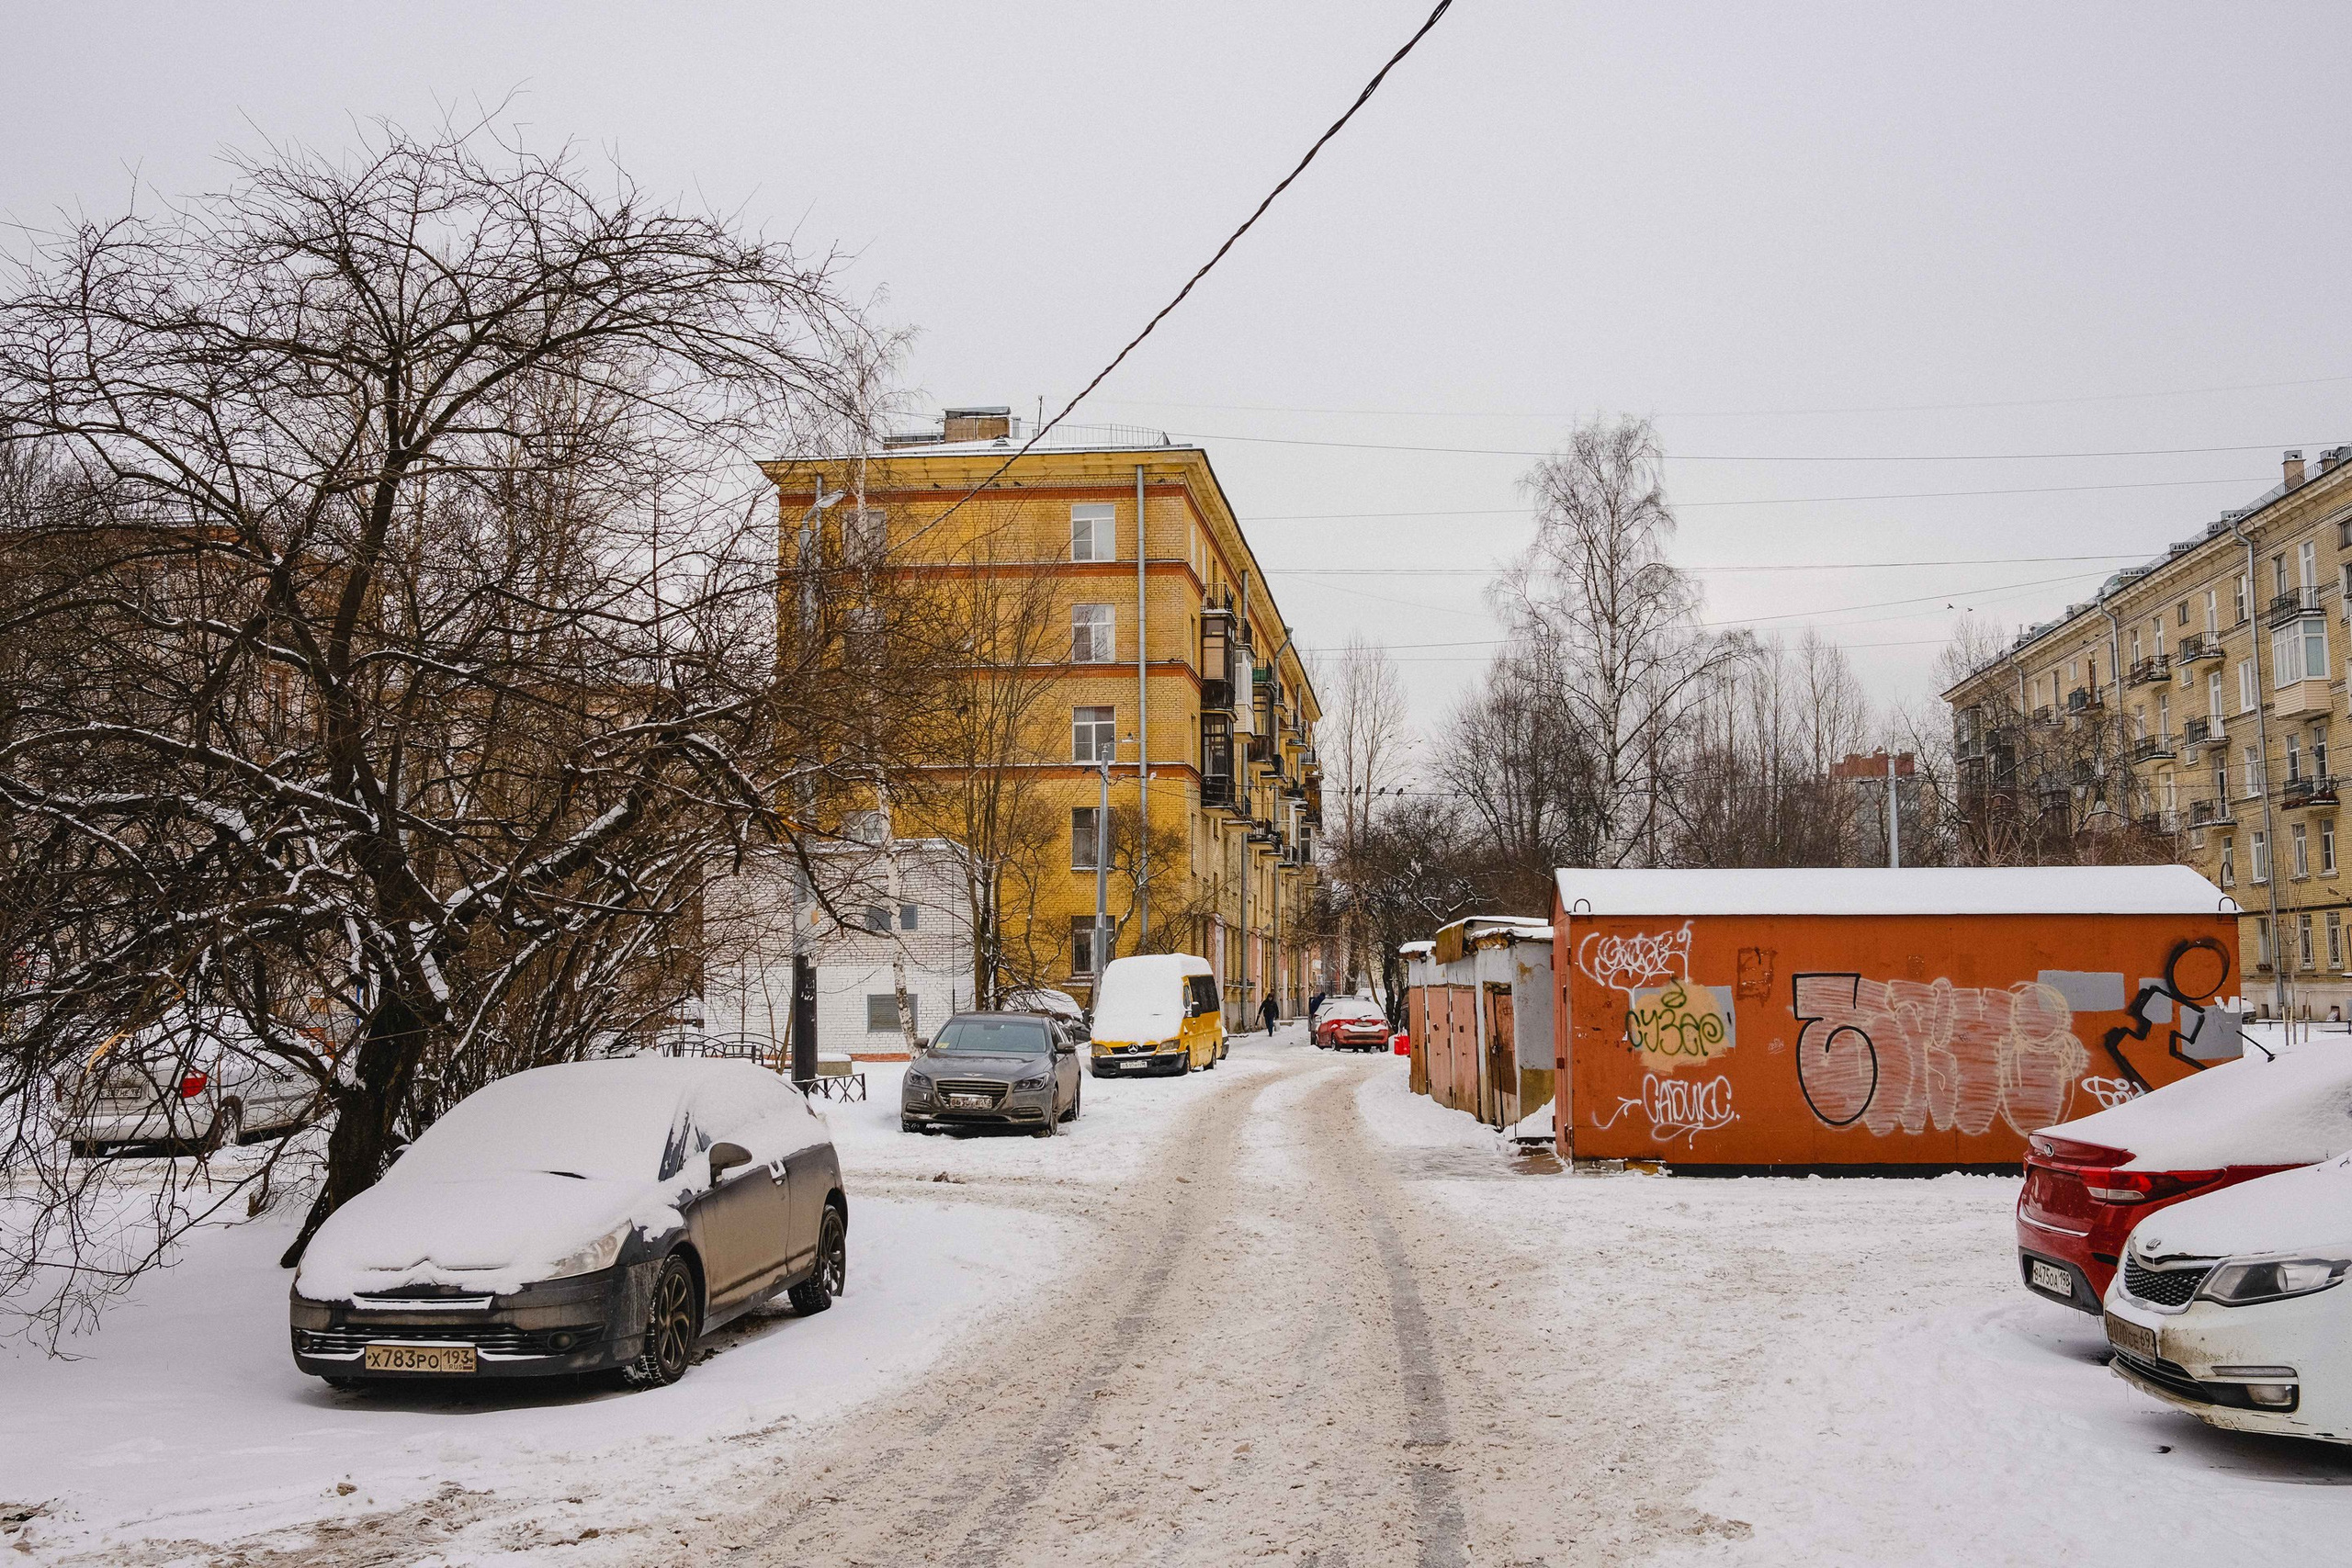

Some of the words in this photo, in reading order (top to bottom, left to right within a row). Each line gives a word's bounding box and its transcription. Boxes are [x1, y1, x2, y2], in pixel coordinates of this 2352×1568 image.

[2140, 1330, 2151, 1348] 69
[370, 1348, 440, 1369] Х783РО
[443, 1350, 470, 1364] 193
